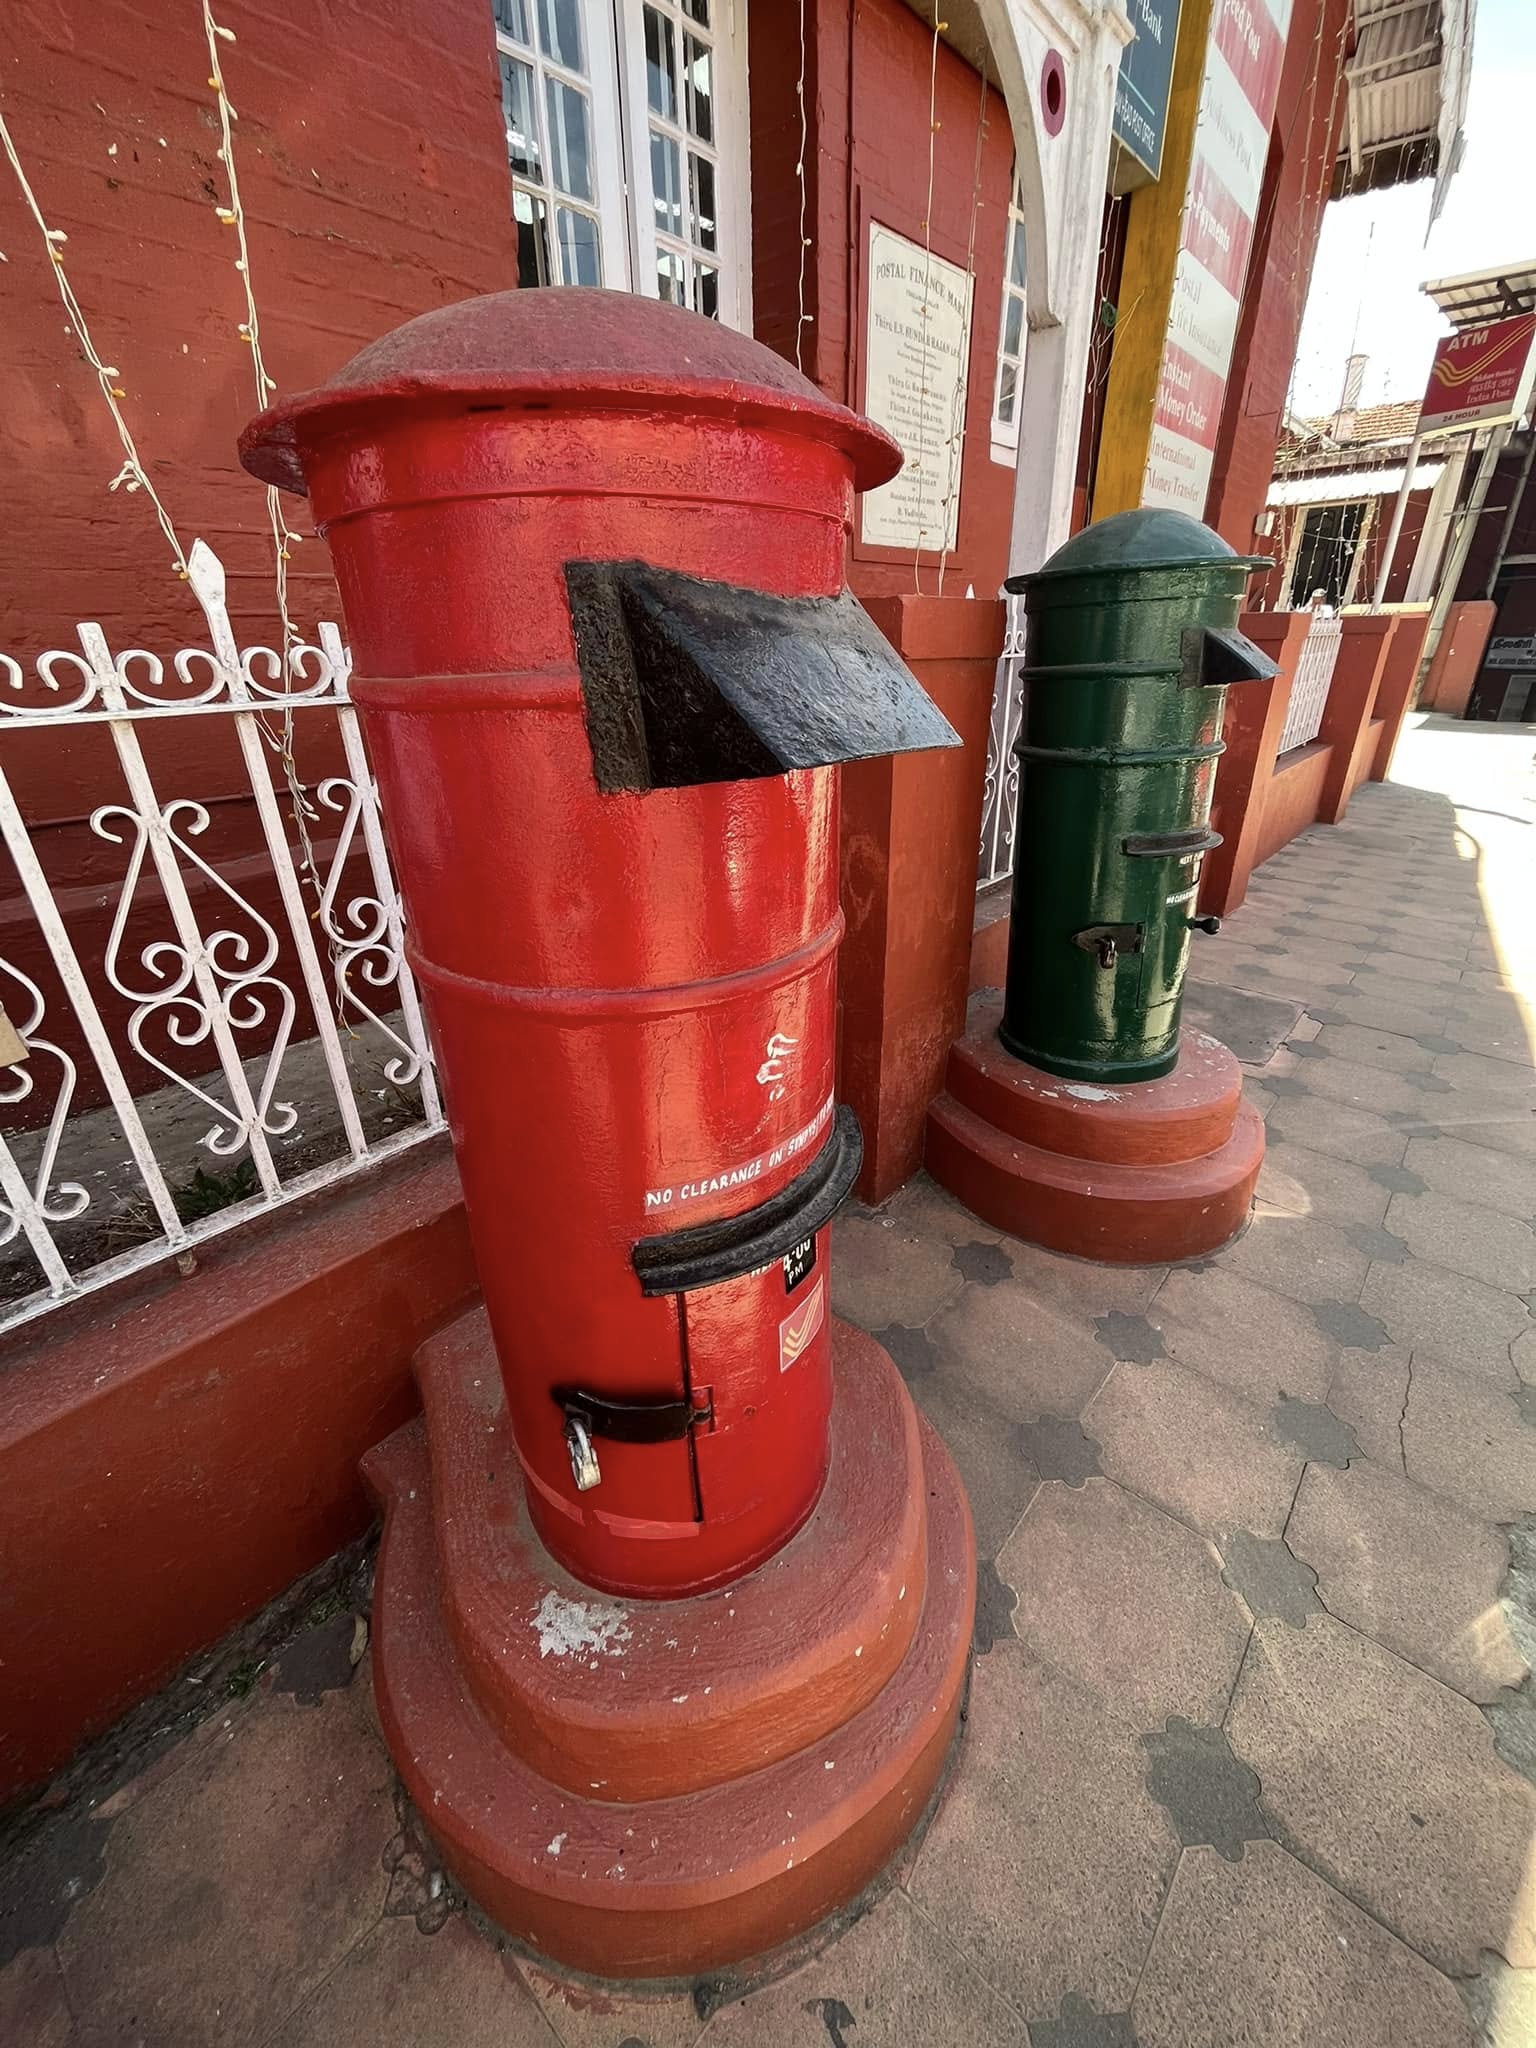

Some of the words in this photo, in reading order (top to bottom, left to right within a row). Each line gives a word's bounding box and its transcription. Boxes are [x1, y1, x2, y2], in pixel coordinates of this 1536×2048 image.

[1142, 0, 1162, 45] Bank
[876, 263, 906, 281] POSTAL
[910, 266, 946, 298] FINANCE
[1447, 330, 1490, 352] ATM
[1162, 351, 1192, 391] Instant
[1158, 384, 1185, 424] Money
[1186, 400, 1207, 432] Order
[1443, 412, 1453, 422] 24
[1455, 409, 1481, 420] HOUR
[1151, 435, 1196, 471] International
[1147, 467, 1172, 499] Money
[1172, 477, 1200, 503] Transfer
[646, 1189, 672, 1207] NO
[681, 1158, 762, 1200] CLEARANCE
[769, 1146, 784, 1168] ON
[788, 1262, 804, 1285] PM
